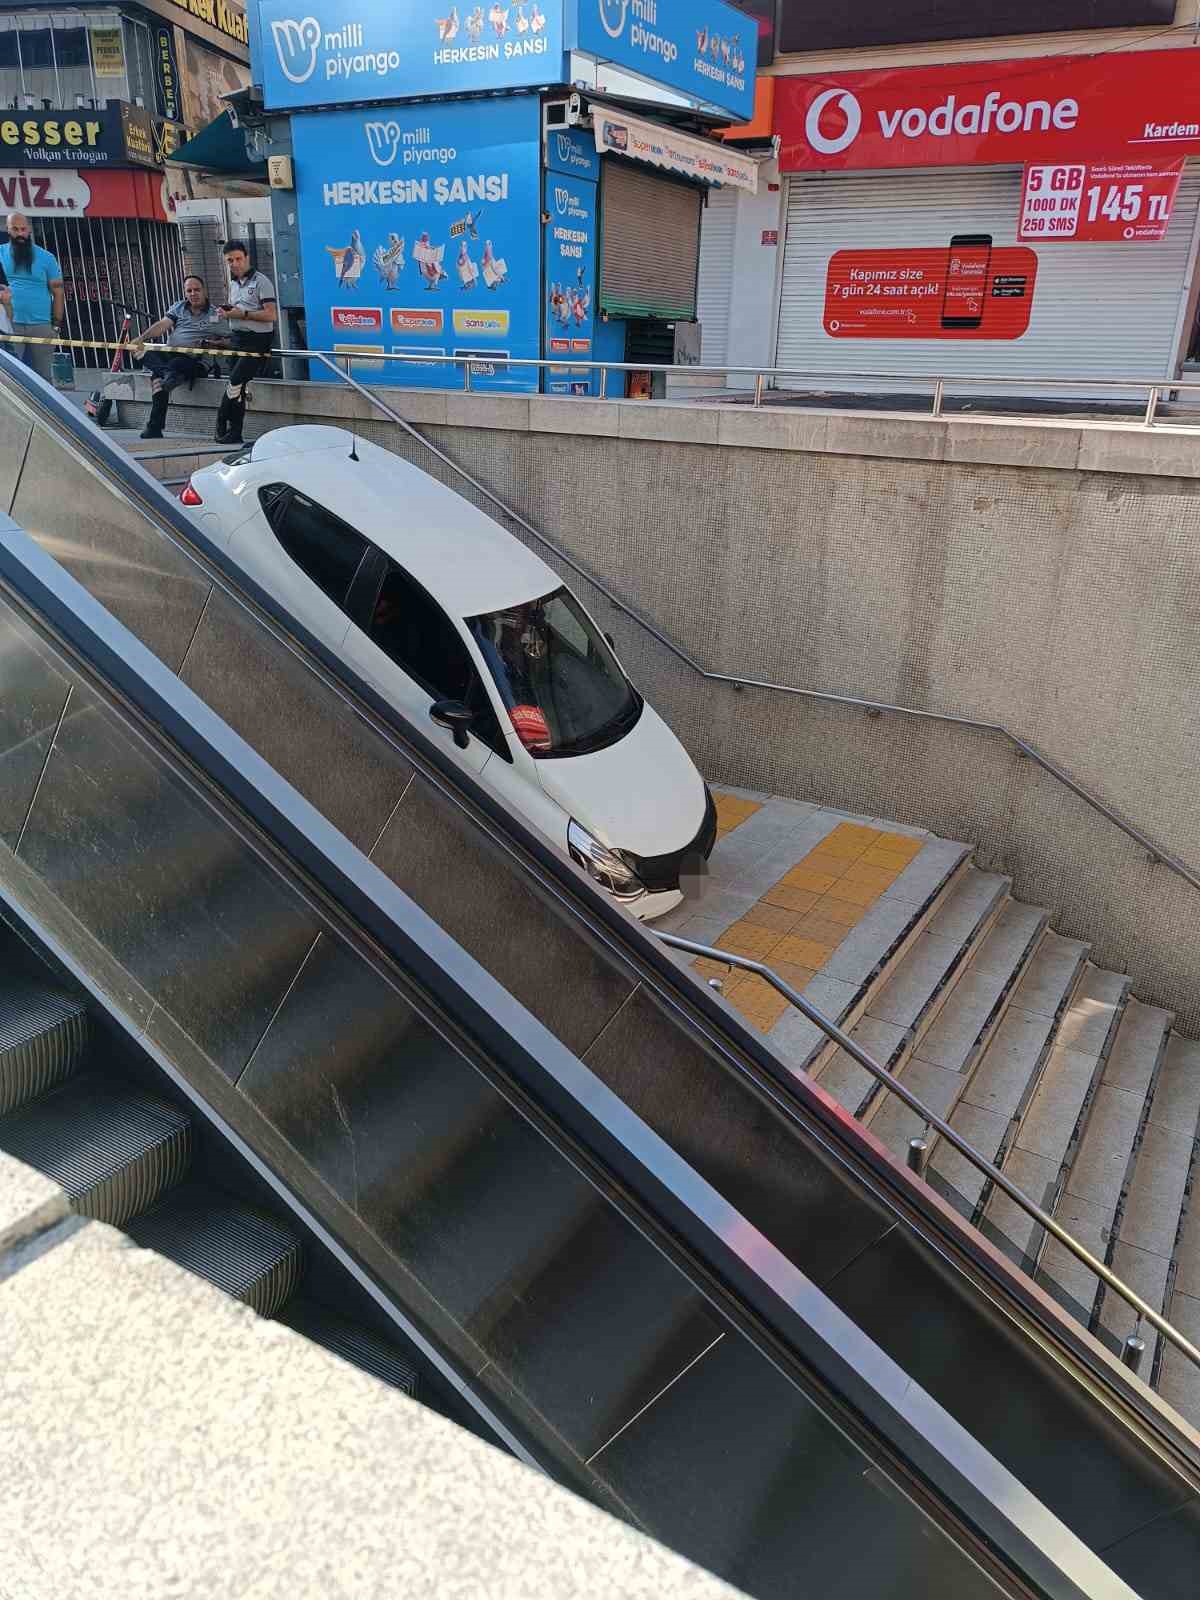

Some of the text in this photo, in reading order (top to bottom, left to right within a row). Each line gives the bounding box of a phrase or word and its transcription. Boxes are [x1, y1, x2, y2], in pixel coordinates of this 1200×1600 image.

[325, 24, 363, 50] milli
[631, 23, 678, 63] piyango
[503, 38, 548, 60] ŞANSI
[326, 51, 400, 81] piyango
[877, 92, 1079, 139] vodafone
[402, 127, 431, 145] milli
[23, 147, 60, 162] Volkan
[403, 146, 457, 165] piyango
[433, 173, 509, 205] ŞANSI
[1029, 167, 1082, 192] 5 GB
[1027, 197, 1078, 212] 1000 DK
[1087, 184, 1170, 222] 145 TL
[1023, 217, 1076, 232] 250 SMS
[850, 267, 924, 283] Kapımız size
[832, 284, 841, 296] 7
[842, 284, 864, 299] gün
[866, 283, 881, 296] 24
[883, 283, 908, 296] saat
[910, 282, 939, 299] açık!
